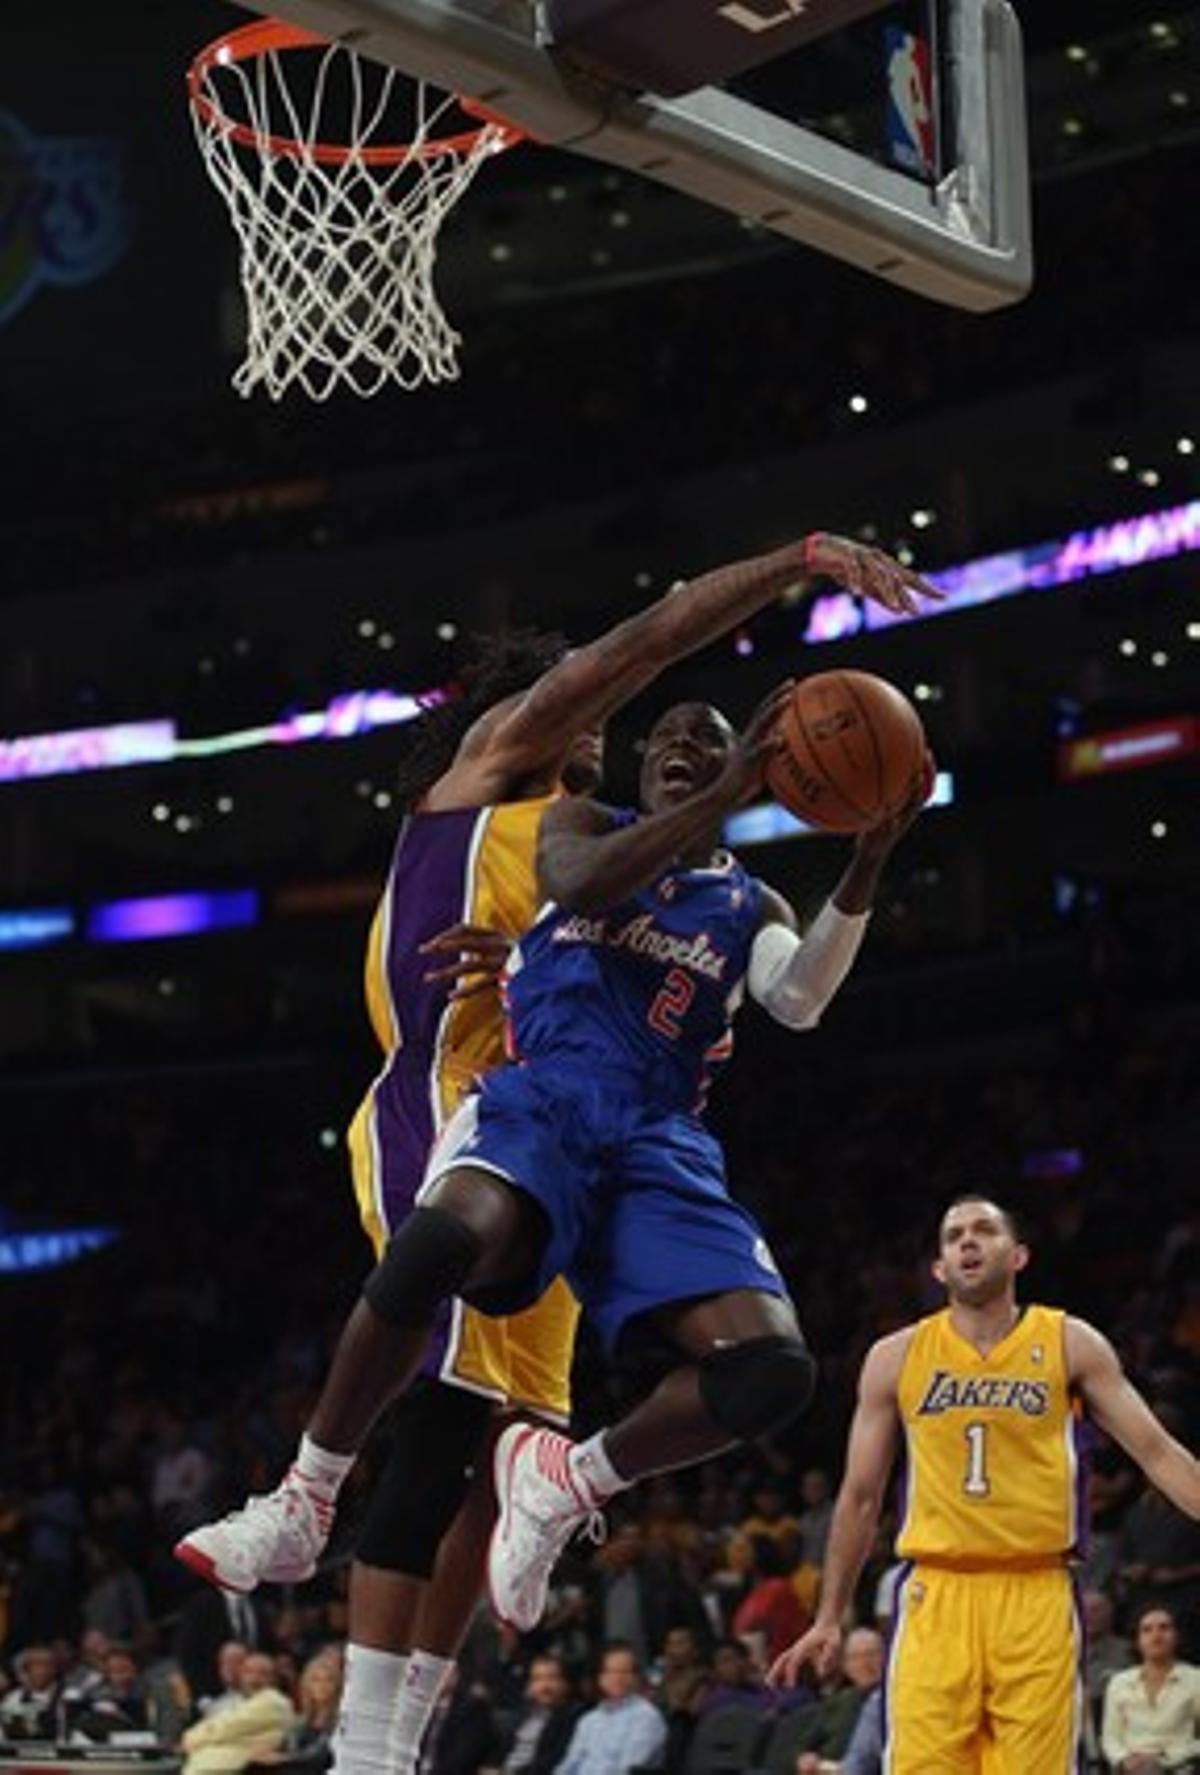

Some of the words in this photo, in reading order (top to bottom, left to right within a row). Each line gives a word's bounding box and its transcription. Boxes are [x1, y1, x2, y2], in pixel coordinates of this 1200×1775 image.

[609, 914, 728, 980] Angeles
[648, 967, 696, 1040] 2
[915, 1369, 1049, 1416] LAKERS
[963, 1422, 990, 1498] 1
